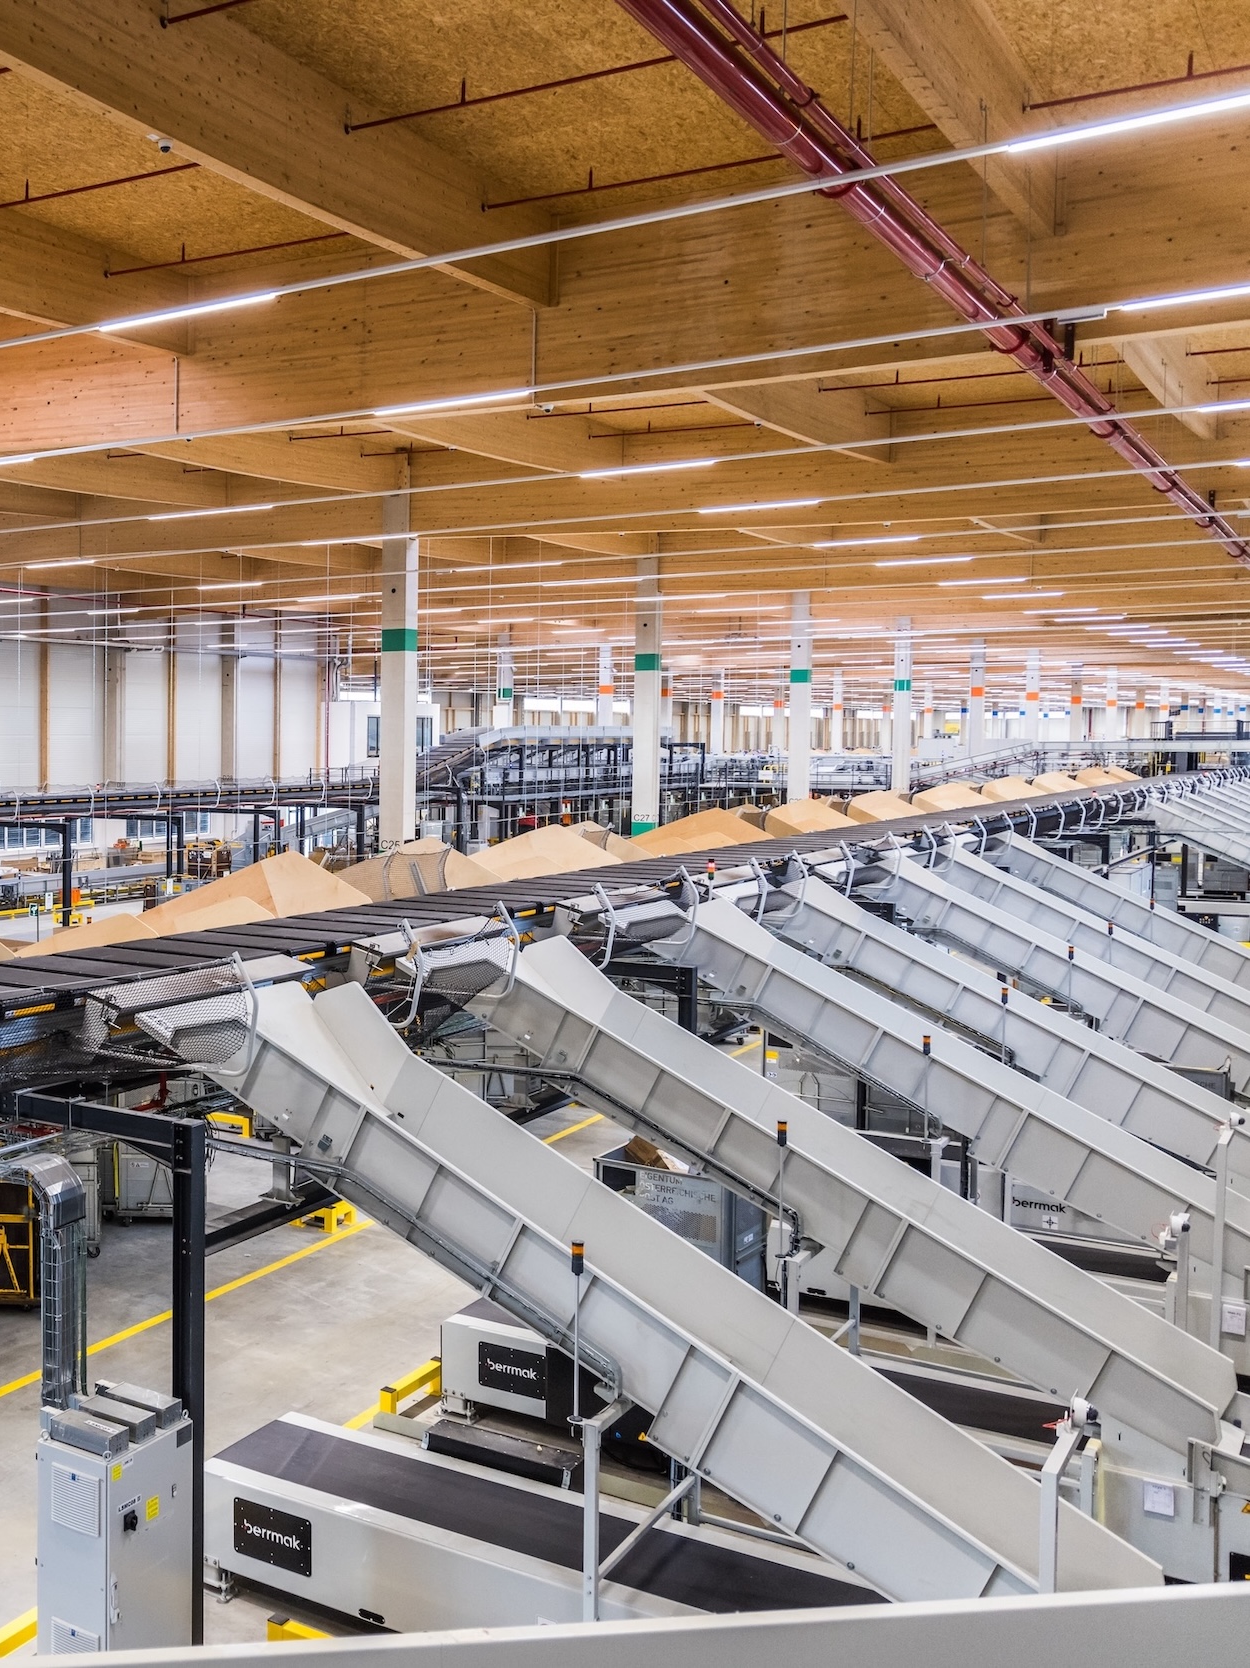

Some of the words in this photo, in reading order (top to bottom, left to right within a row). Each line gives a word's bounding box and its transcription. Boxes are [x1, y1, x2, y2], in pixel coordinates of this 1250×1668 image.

[633, 813, 650, 822] C27
[1012, 1196, 1067, 1214] berrmak
[486, 1358, 537, 1381] berrmak
[243, 1518, 301, 1551] berrmak
